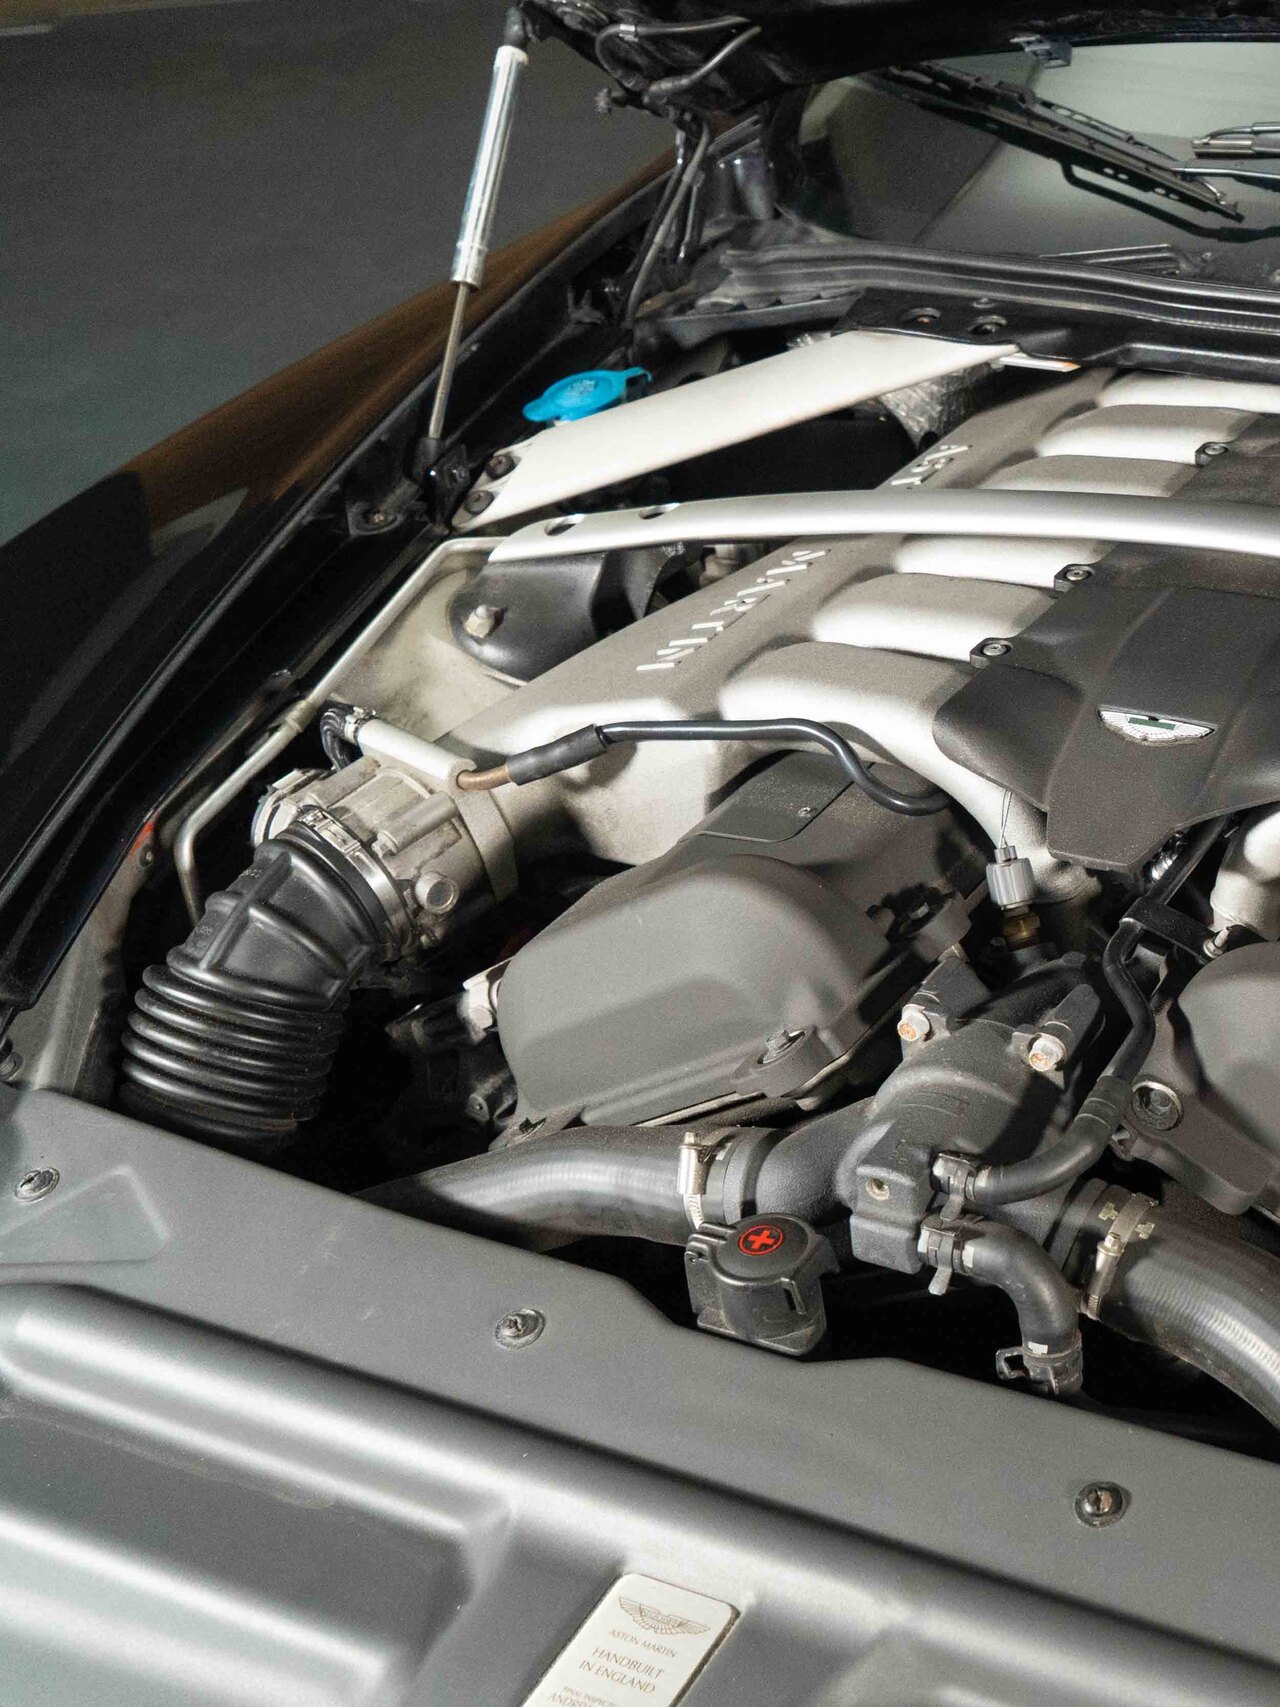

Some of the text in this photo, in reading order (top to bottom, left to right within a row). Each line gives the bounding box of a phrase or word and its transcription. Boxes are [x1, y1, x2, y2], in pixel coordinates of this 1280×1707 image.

[608, 1629, 679, 1658] ASTON MARTIN
[579, 1659, 656, 1694] IN ENGLAND
[592, 1647, 664, 1679] HANDBUILT
